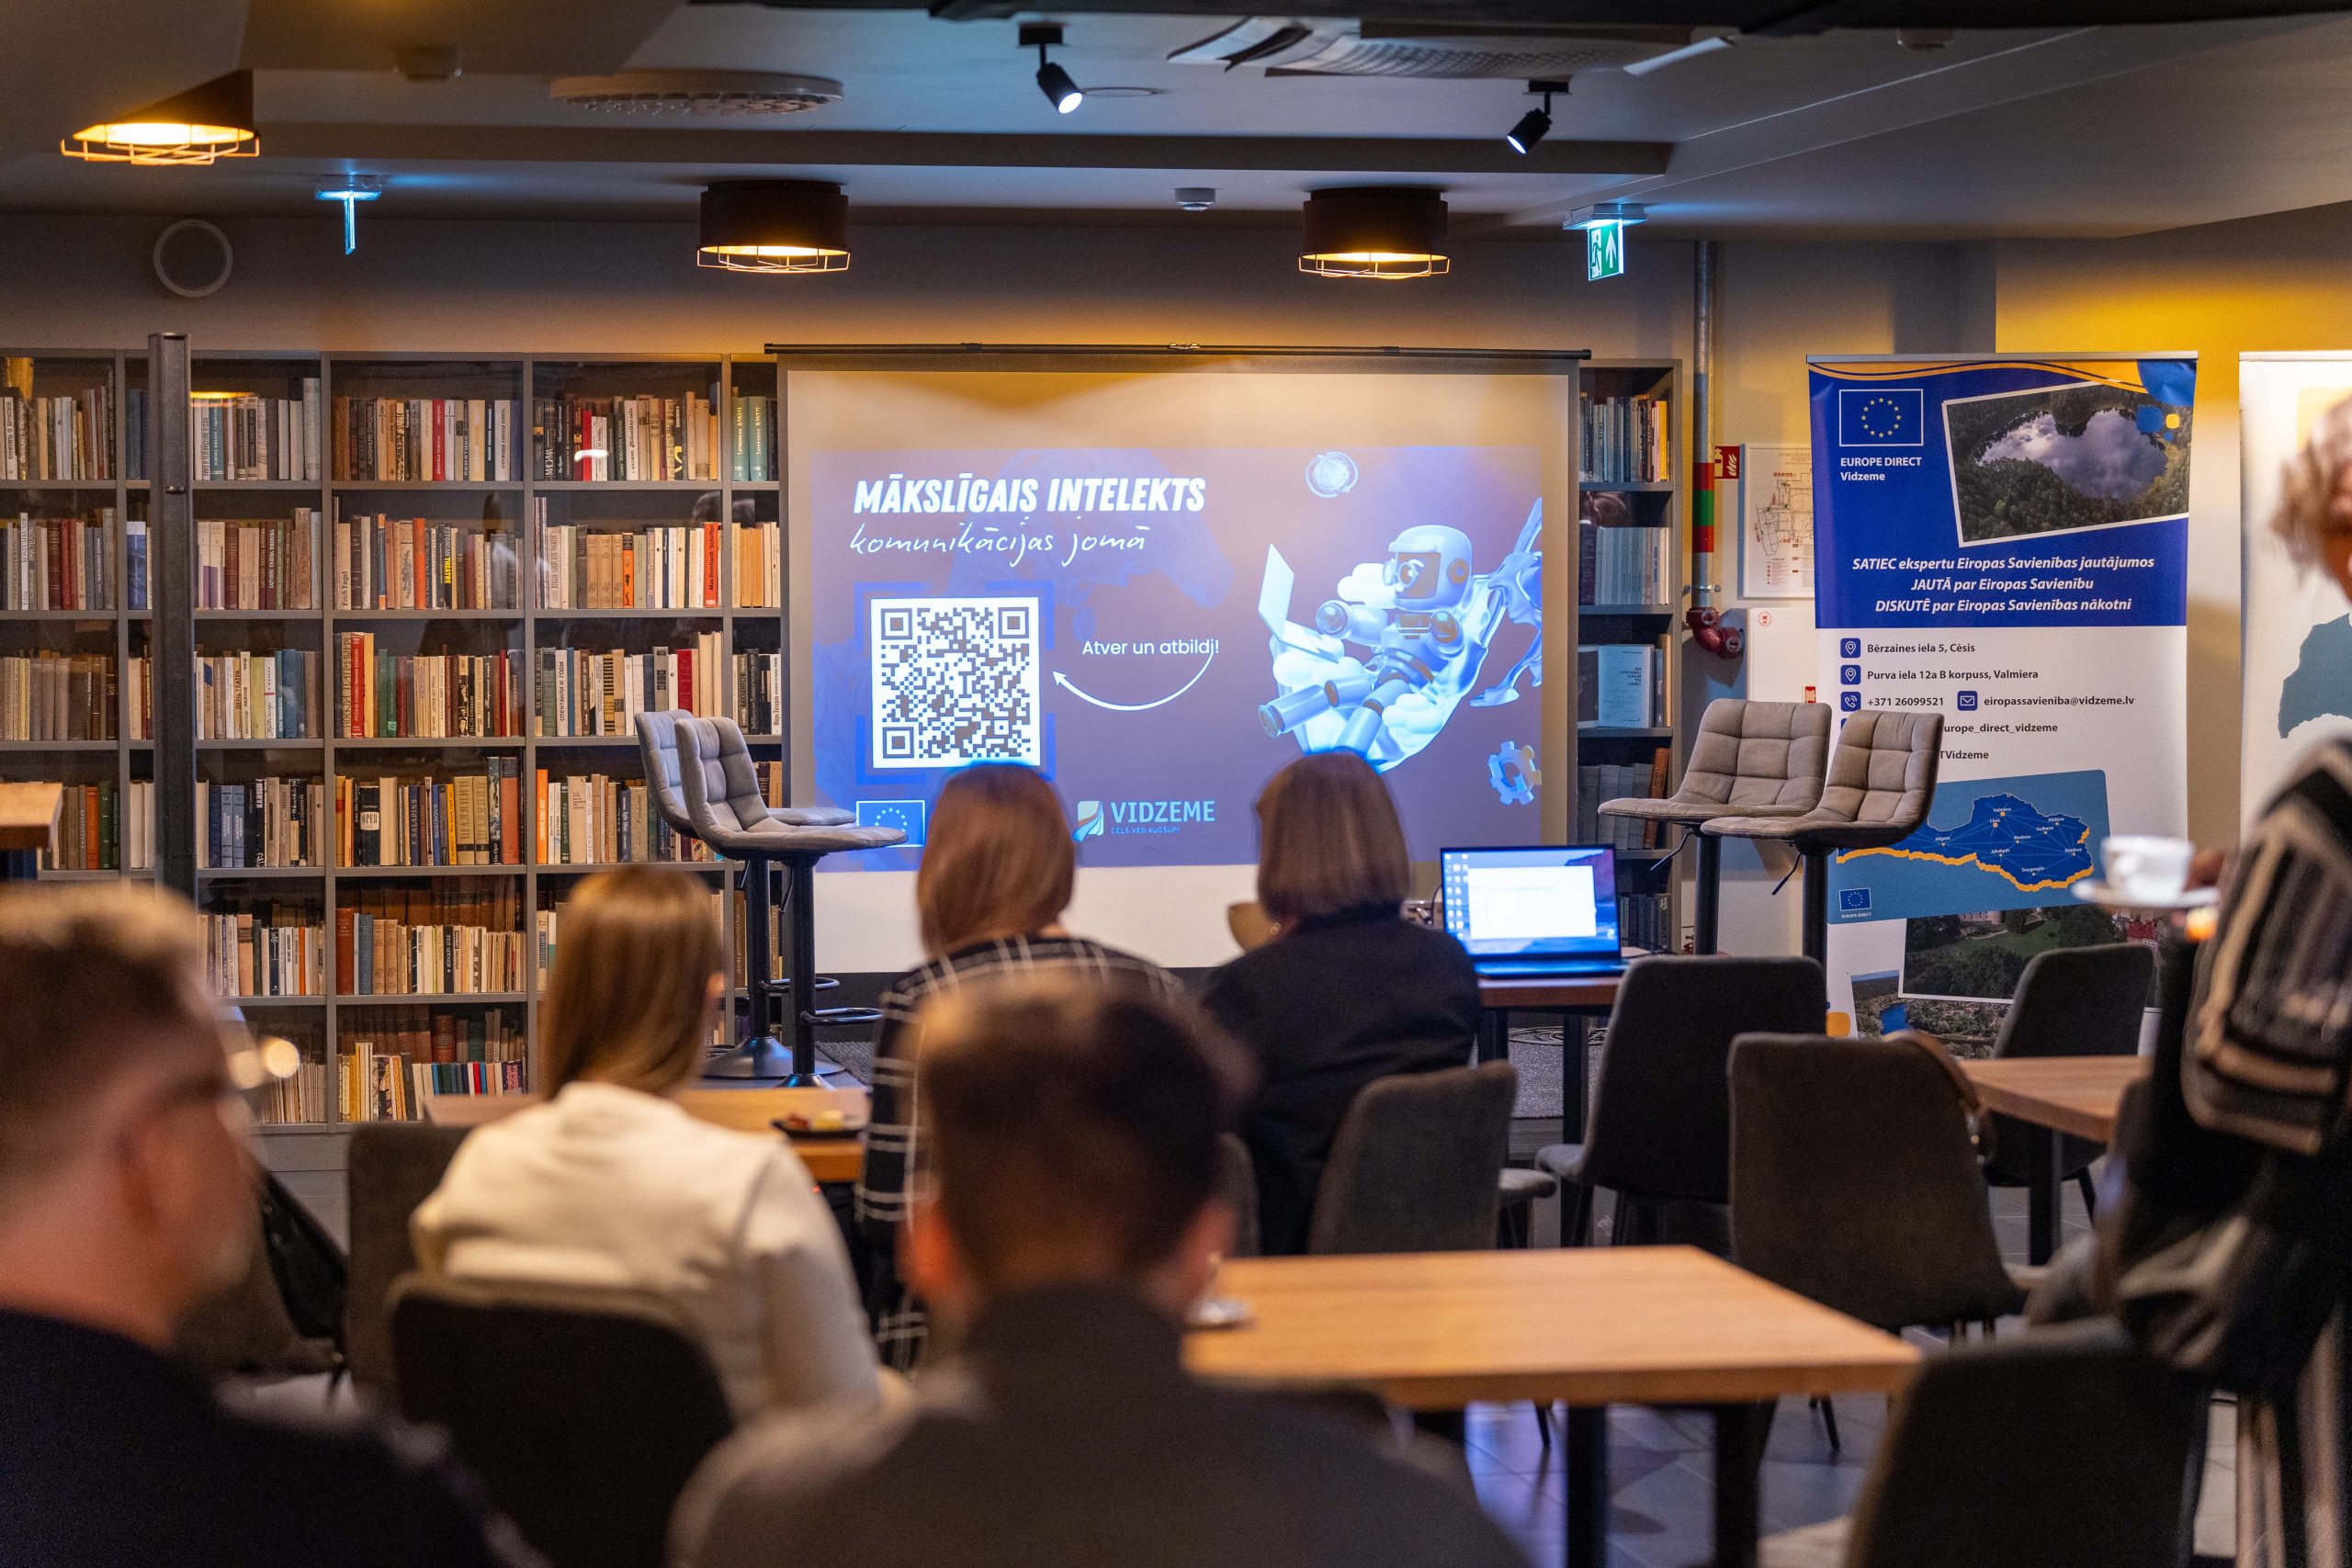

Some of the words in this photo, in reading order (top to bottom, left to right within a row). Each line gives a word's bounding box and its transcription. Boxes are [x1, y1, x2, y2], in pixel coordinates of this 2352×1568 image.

[1840, 457, 1883, 468] EUROPE
[1884, 456, 1922, 467] DIRECT
[1840, 470, 1885, 481] Vidzeme
[854, 473, 1038, 513] MĀKSLĪGAIS
[1046, 477, 1206, 512] INTELEKTS
[849, 516, 1054, 567] komunikācijas
[1061, 516, 1150, 567] jomā
[1852, 557, 1897, 570] SATIEC
[1898, 557, 1955, 572] ekspertu
[1957, 556, 2006, 572] Eiropas
[2007, 555, 2077, 570] Savienības
[2078, 555, 2154, 570] jautājumos
[1911, 575, 1952, 591] JAUTĀ
[1953, 581, 1976, 593] par
[1978, 577, 2027, 592] Eiropas
[2030, 576, 2094, 591] Savienību
[1875, 597, 1931, 613] DISKUTĒ
[1931, 602, 1955, 615] par
[1957, 598, 2006, 614] Eiropas
[2007, 597, 2078, 612] Savienības
[2080, 597, 2132, 612] nākotni
[1082, 640, 1128, 656] Atver
[1133, 643, 1155, 656] un
[1867, 643, 1916, 653] Bērzaines
[1917, 643, 1935, 653] iela
[1938, 644, 1948, 655] 5,
[1951, 642, 1975, 653] Cēsis
[1867, 670, 1896, 680] Purva
[1898, 670, 1917, 680] iela
[1919, 670, 1937, 680] 12a
[1939, 670, 1947, 680] B
[1949, 669, 1991, 682] korpuss,
[1993, 669, 2039, 680] Valmiera
[1867, 696, 1893, 707] +371
[1894, 696, 1944, 707] 26099521
[1944, 723, 2058, 734] urope_direct_vidzeme
[1939, 750, 1989, 760] TVidzeme
[459, 781, 469, 840] ШАЛЯПИН
[477, 782, 487, 840] ШАЛЯПИН
[1110, 800, 1216, 823] VIDZEME
[361, 814, 378, 824] OPER
